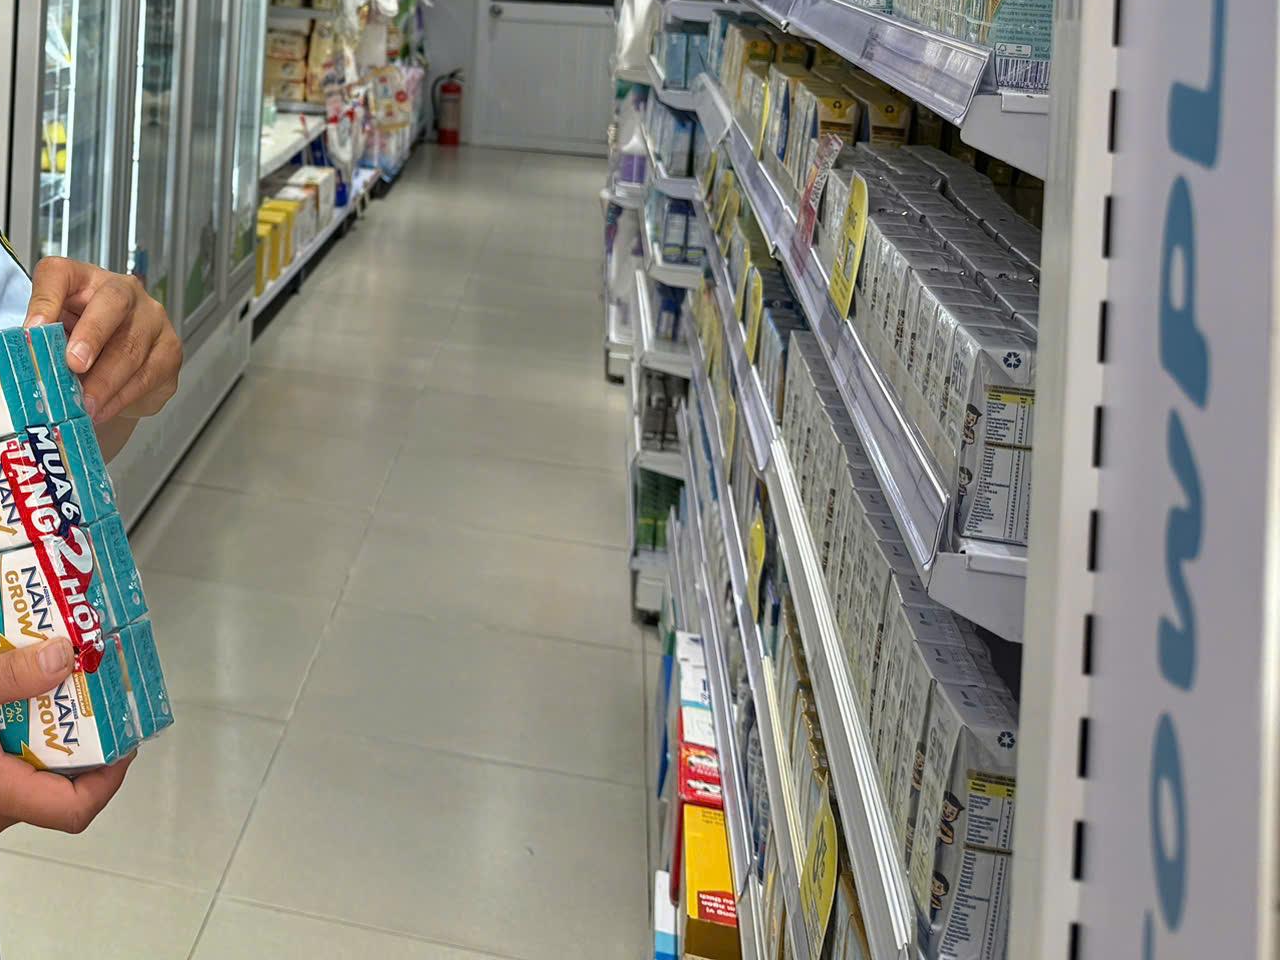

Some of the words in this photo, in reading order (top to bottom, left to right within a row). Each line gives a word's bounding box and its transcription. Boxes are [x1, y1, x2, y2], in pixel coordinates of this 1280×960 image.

[5, 444, 61, 535] TẶNG
[39, 526, 93, 577] 2
[28, 425, 72, 492] MUA
[62, 504, 81, 522] 6
[4, 569, 49, 641] GROW
[20, 565, 54, 631] NAN
